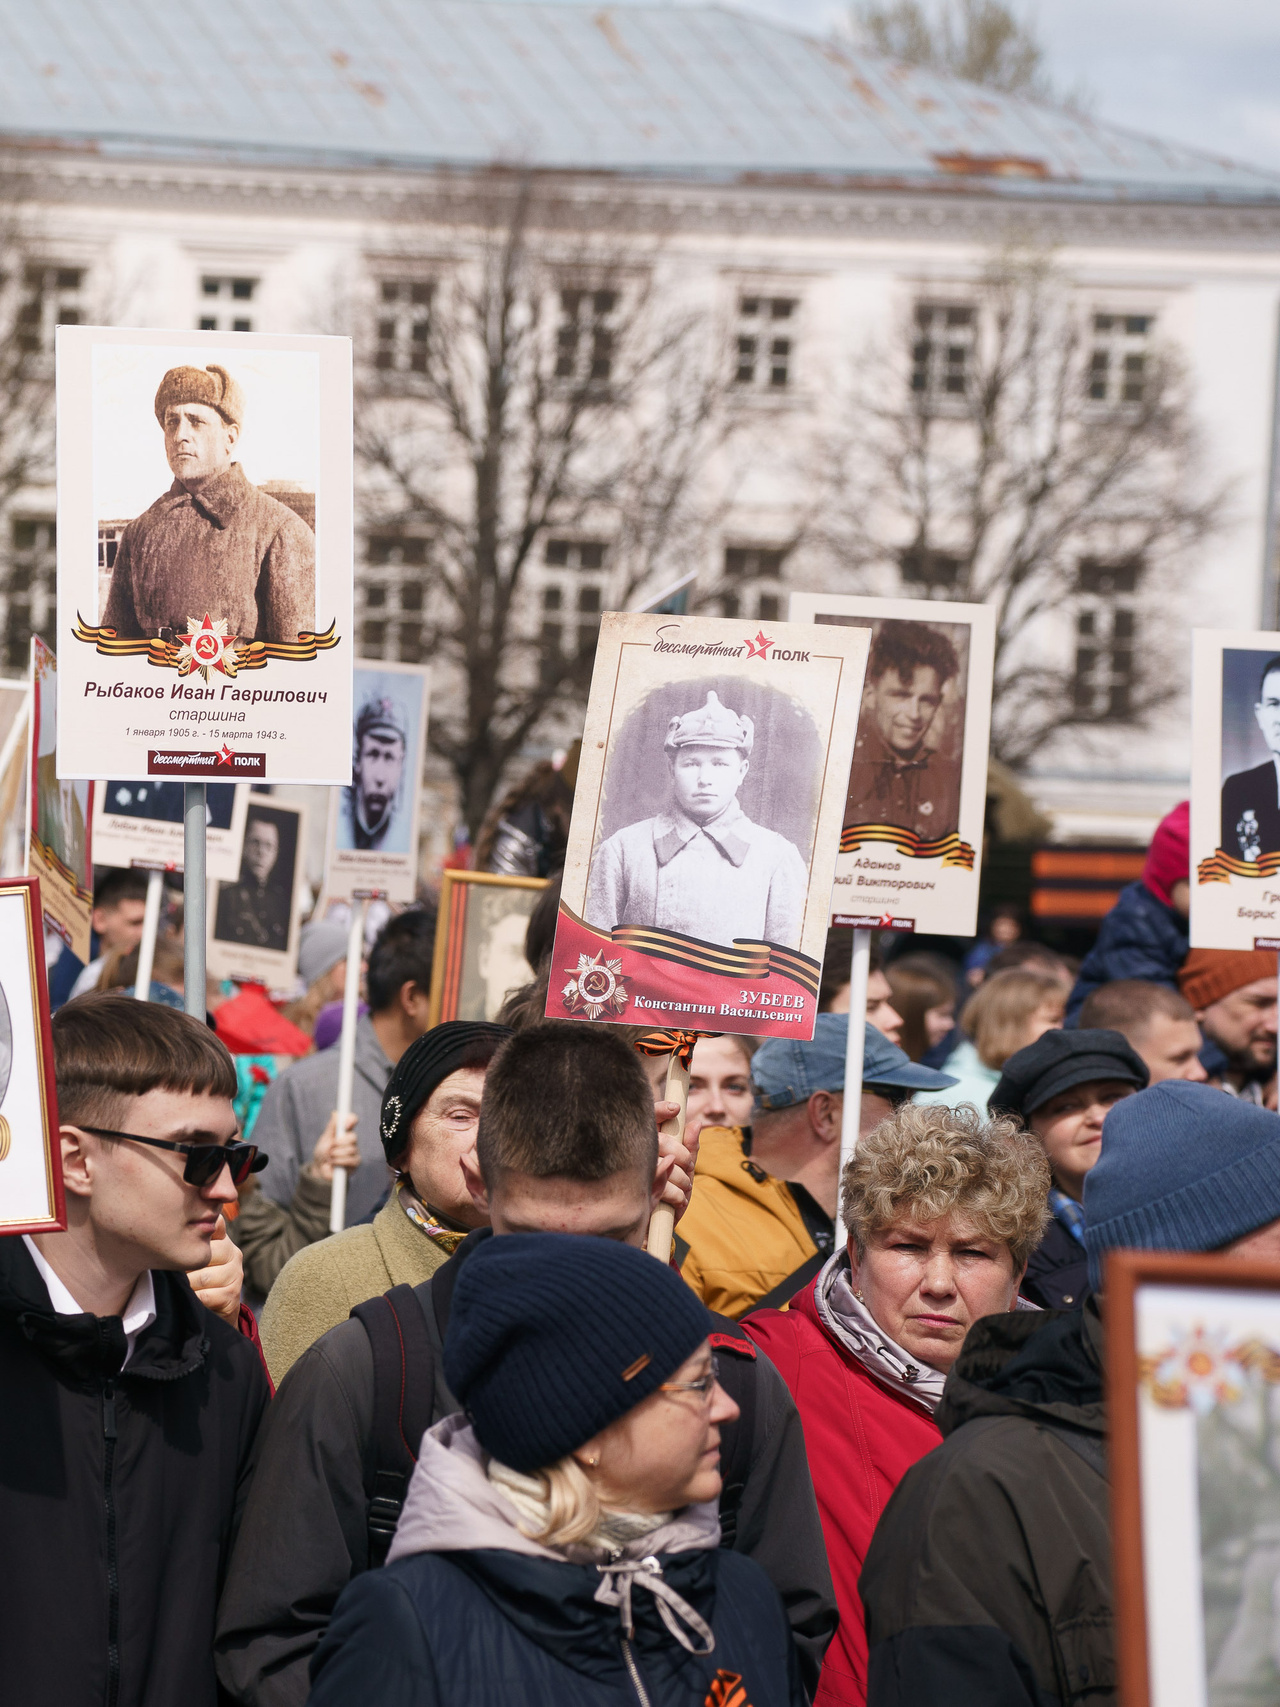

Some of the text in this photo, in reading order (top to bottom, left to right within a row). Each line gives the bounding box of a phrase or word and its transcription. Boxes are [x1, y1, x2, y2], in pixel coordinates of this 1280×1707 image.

[653, 624, 811, 662] бессмертный ПОЛК
[84, 681, 328, 705] Рыбаков Иван Гаврилович
[169, 708, 247, 724] старшина
[125, 727, 131, 736] 1
[132, 729, 165, 738] января
[168, 728, 190, 738] 1905
[209, 729, 220, 738] 15
[222, 730, 253, 740] марта
[256, 730, 277, 740] 1943
[279, 732, 287, 740] г.
[153, 749, 261, 768] бессмертный ПОЛК
[854, 858, 902, 871] Адамов
[856, 875, 936, 891] Викторович
[1237, 906, 1276, 920] Борис
[738, 990, 805, 1009] ЗУБЕЕВ
[634, 995, 803, 1023] Константин Васильевич
